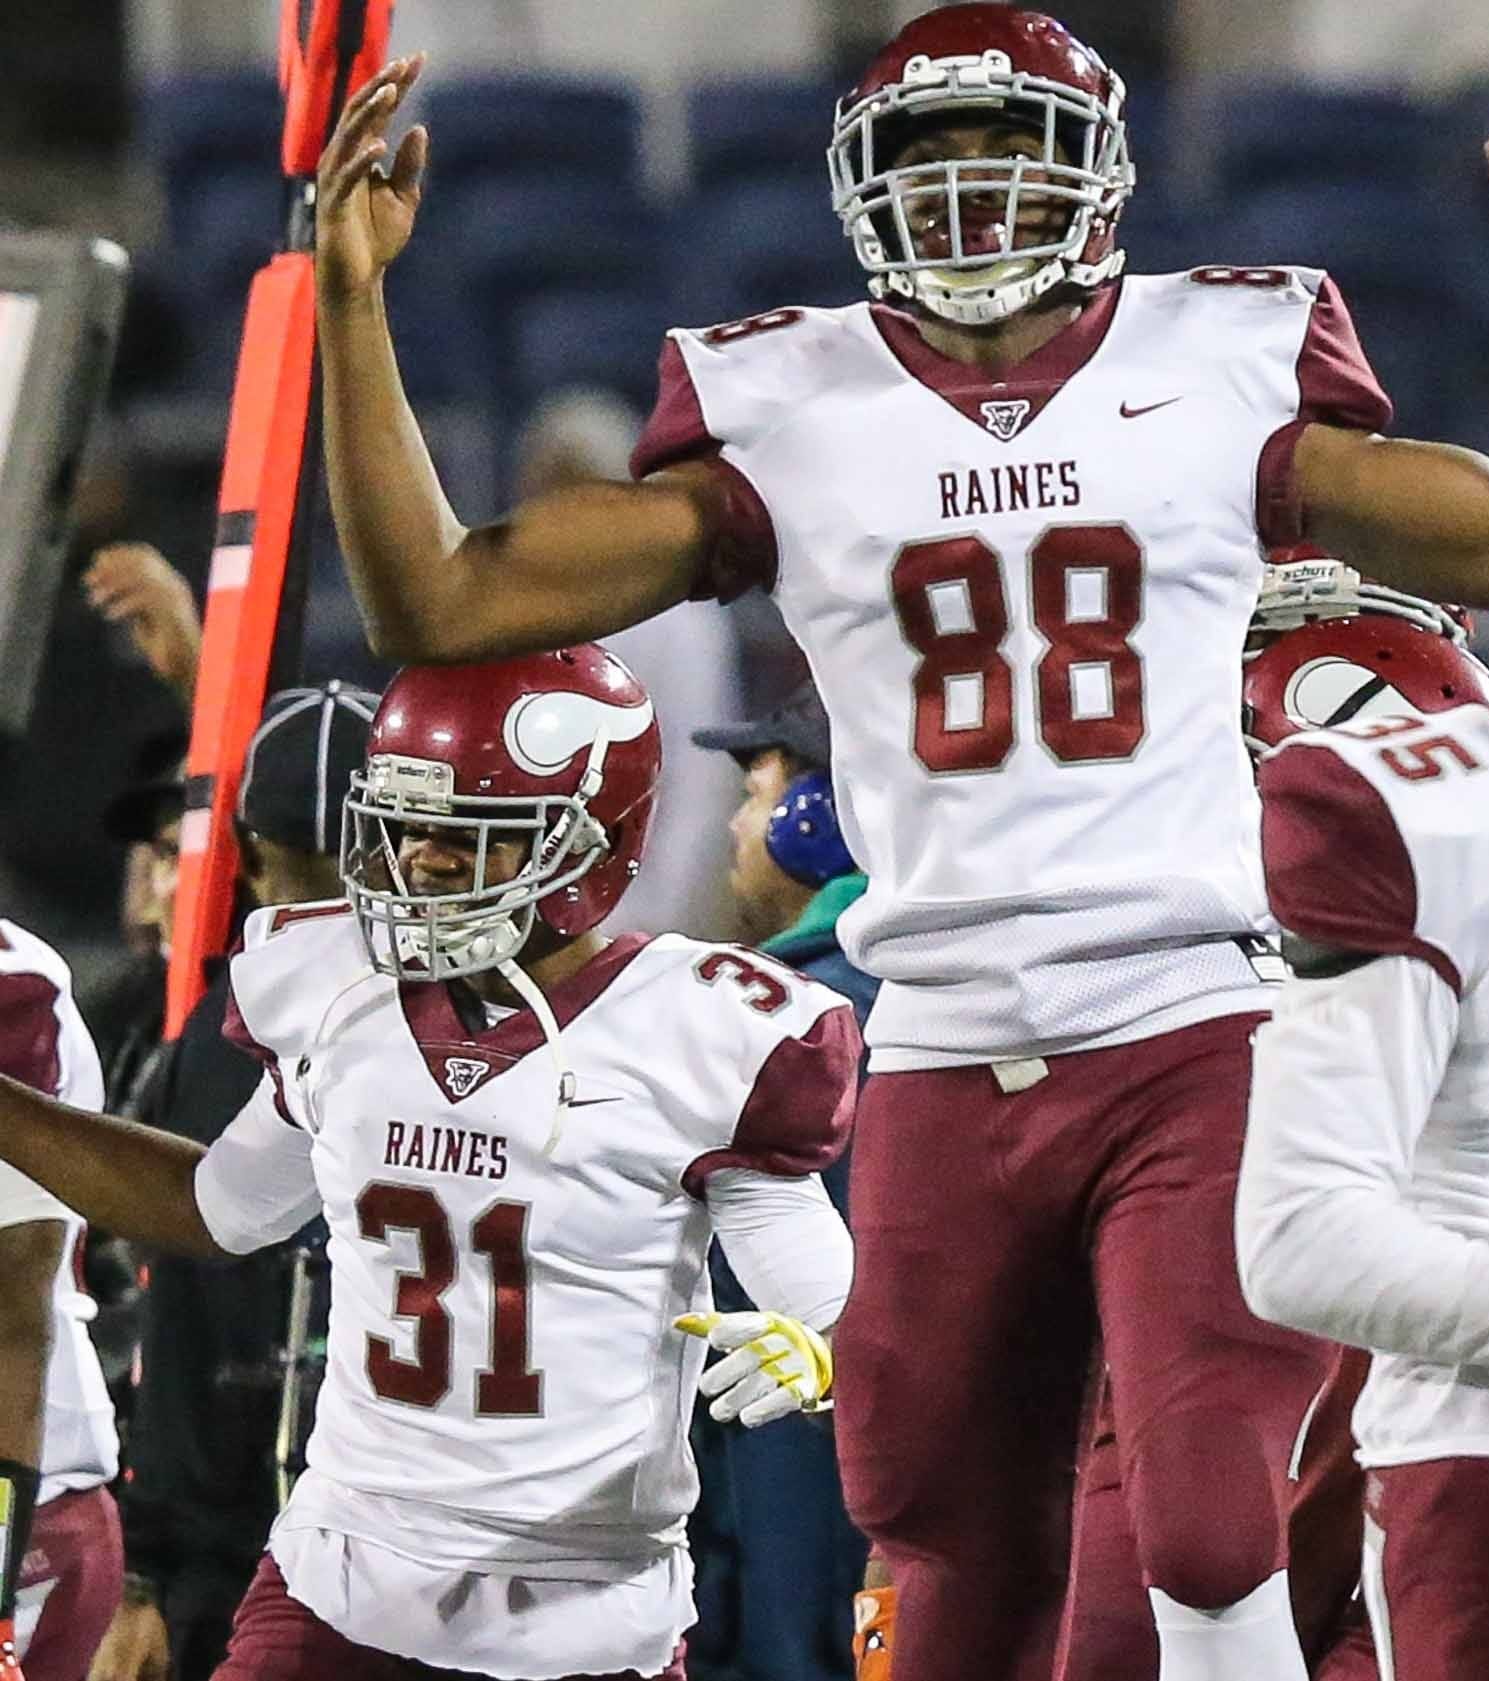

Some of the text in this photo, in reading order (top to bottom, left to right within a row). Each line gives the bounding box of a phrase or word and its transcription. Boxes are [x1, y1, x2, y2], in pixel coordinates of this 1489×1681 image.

[937, 460, 1081, 520] RAINES
[889, 519, 1148, 778] 88
[691, 944, 793, 1018] 3
[383, 1119, 508, 1181] RAINES
[354, 1178, 545, 1418] 31
